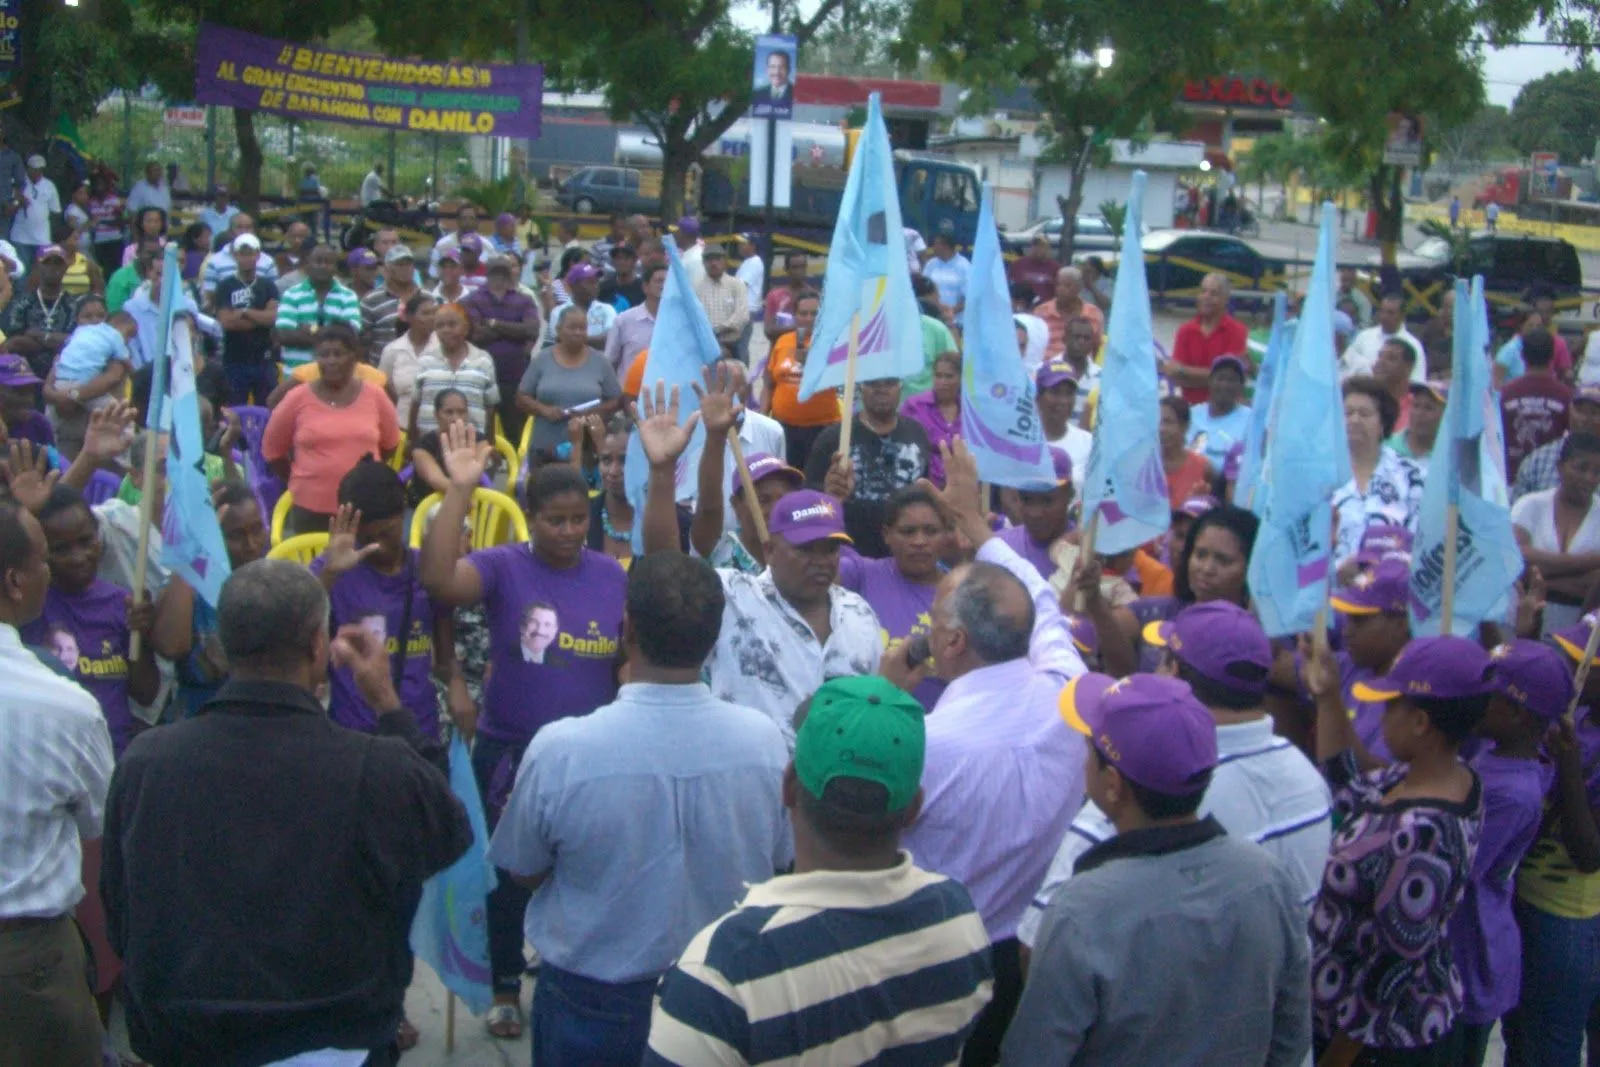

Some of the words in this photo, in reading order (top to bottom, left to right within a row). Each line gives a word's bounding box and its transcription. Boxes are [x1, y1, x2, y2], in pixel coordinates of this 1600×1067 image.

[216, 60, 238, 81] AL
[242, 65, 285, 88] GRAN
[285, 73, 365, 100] ENCUENTRO
[1184, 77, 1292, 108] EXACO
[259, 88, 285, 107] DE
[286, 94, 370, 120] BARAHONA
[372, 105, 403, 124] CON
[408, 107, 495, 134] DANILO
